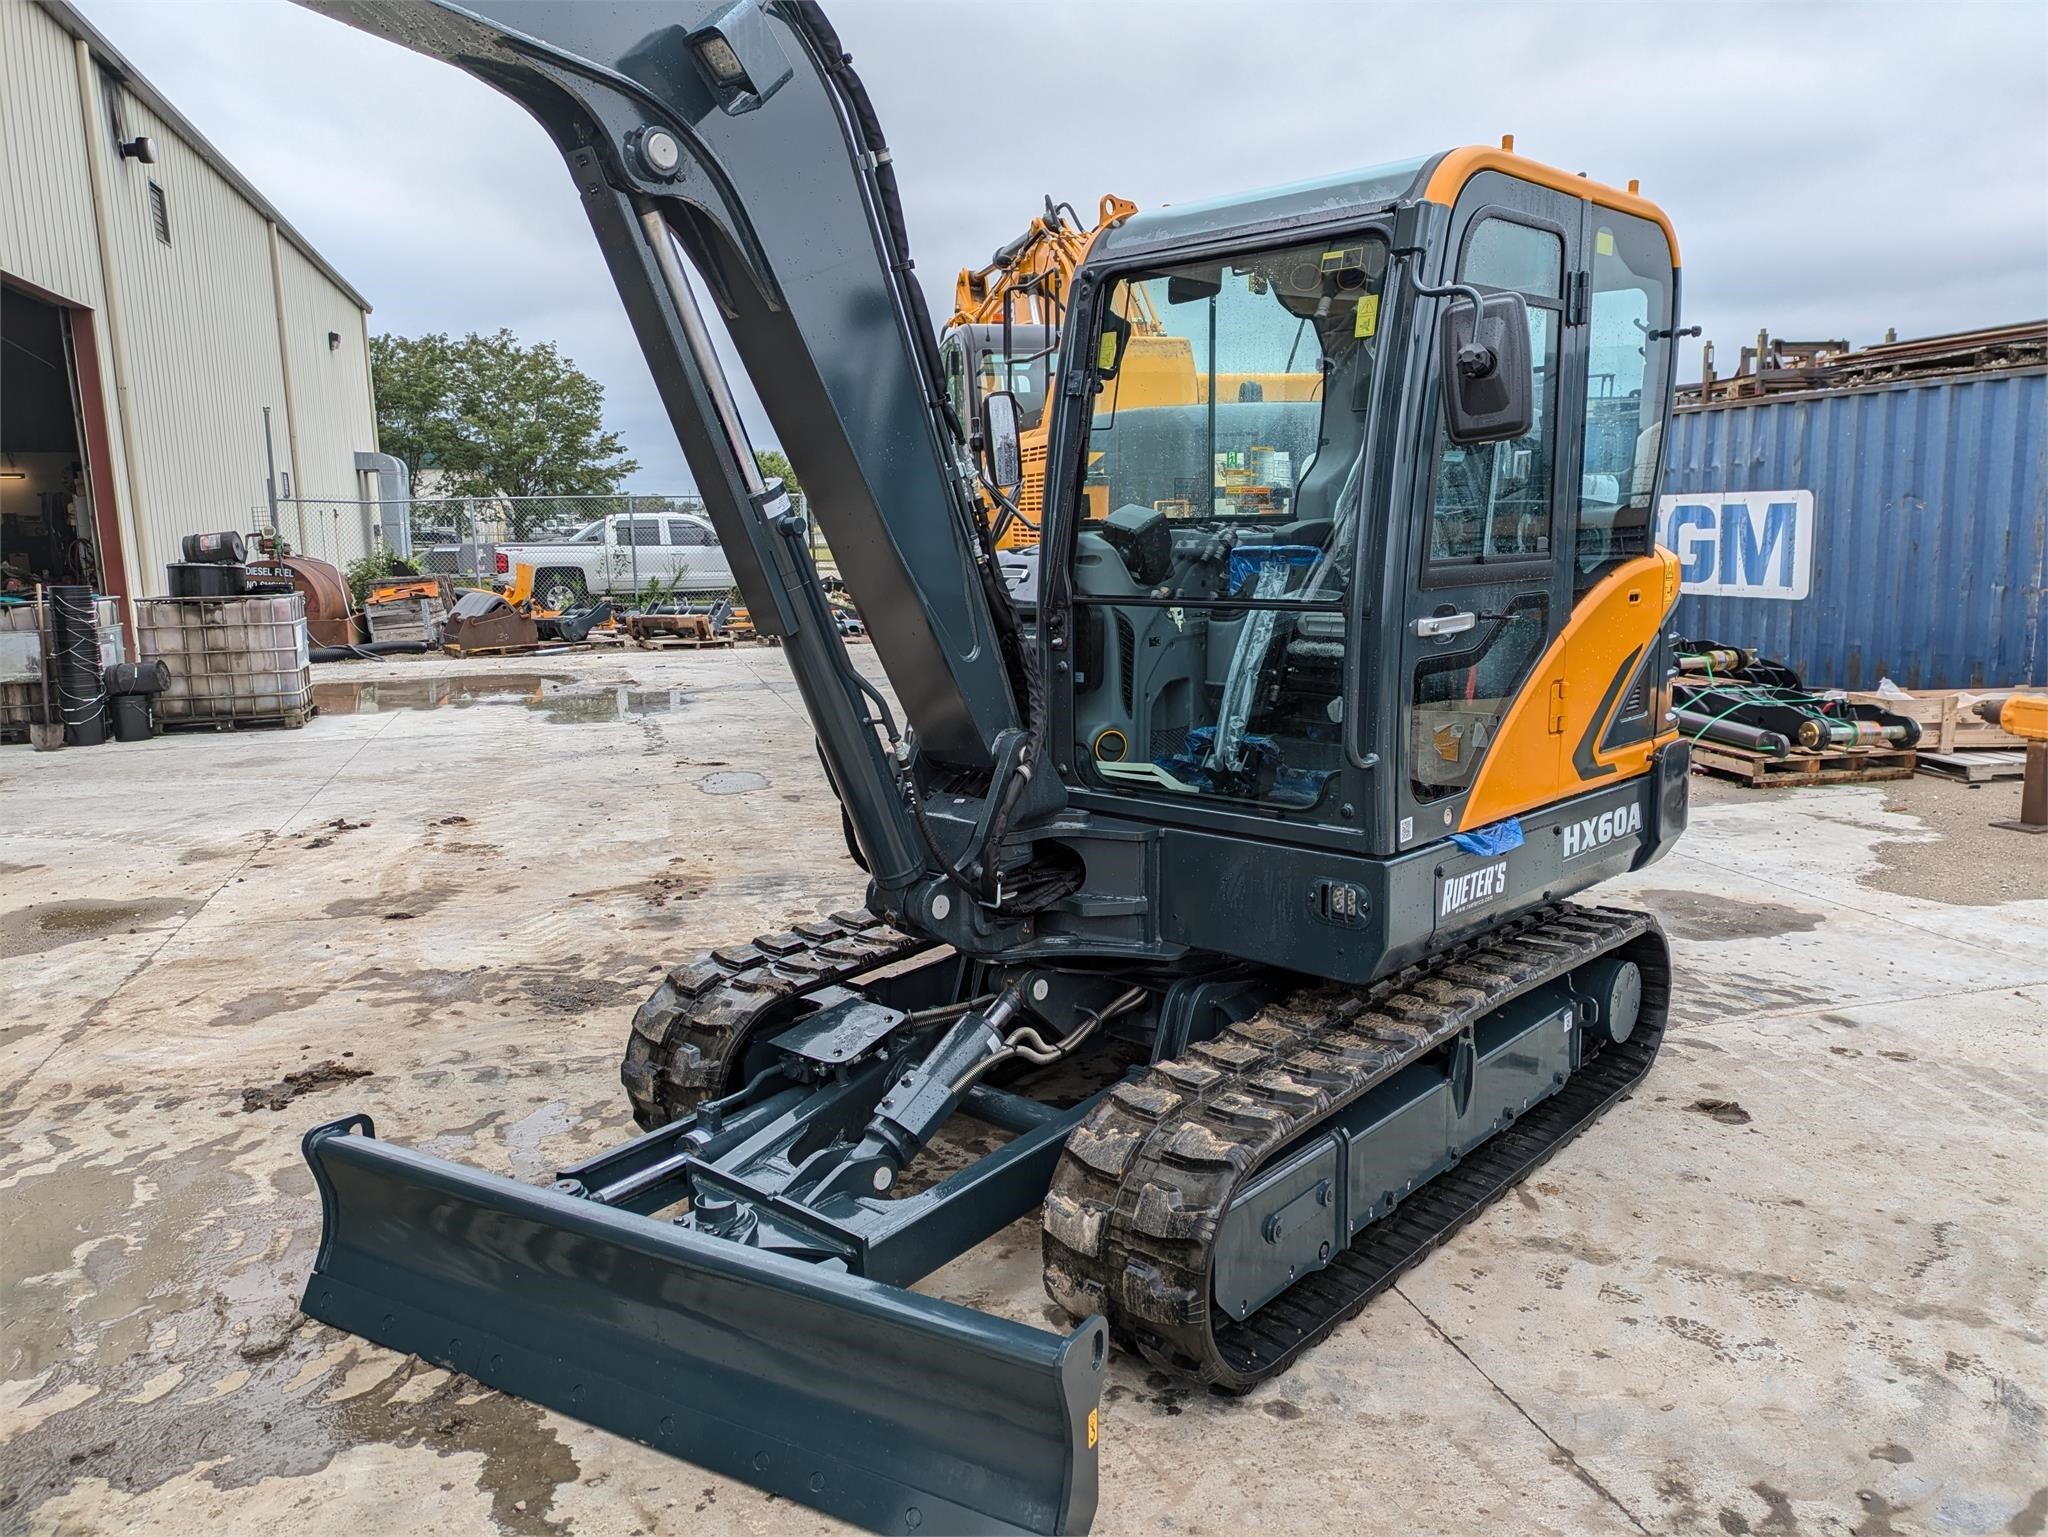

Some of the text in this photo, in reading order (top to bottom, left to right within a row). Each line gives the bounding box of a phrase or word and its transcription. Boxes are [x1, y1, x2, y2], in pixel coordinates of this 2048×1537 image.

[245, 566, 294, 578] DIESEL FUEL
[1656, 502, 1798, 588] GM
[1563, 802, 1642, 858] HX60A
[1441, 861, 1507, 917] RUETER'S
